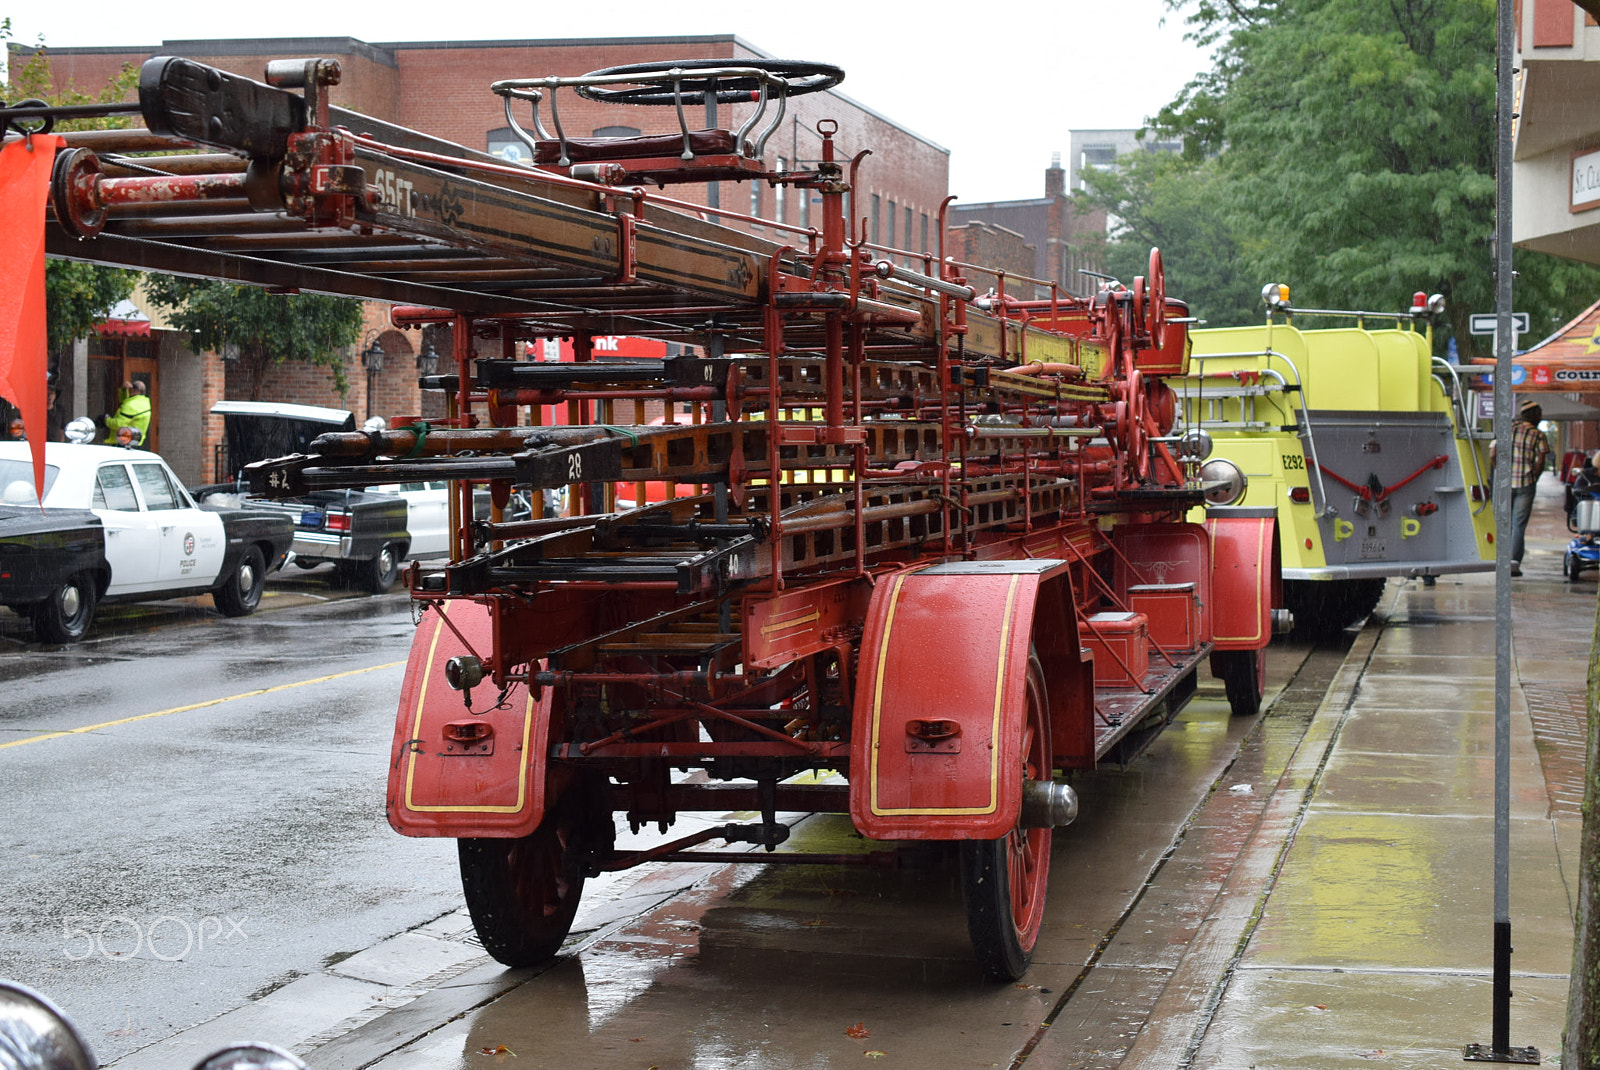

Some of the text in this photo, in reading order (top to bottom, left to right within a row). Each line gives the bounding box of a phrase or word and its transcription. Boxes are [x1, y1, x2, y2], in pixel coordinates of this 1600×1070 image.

[568, 452, 582, 480] 28
[1282, 454, 1304, 470] E292
[180, 559, 197, 568] POLICE
